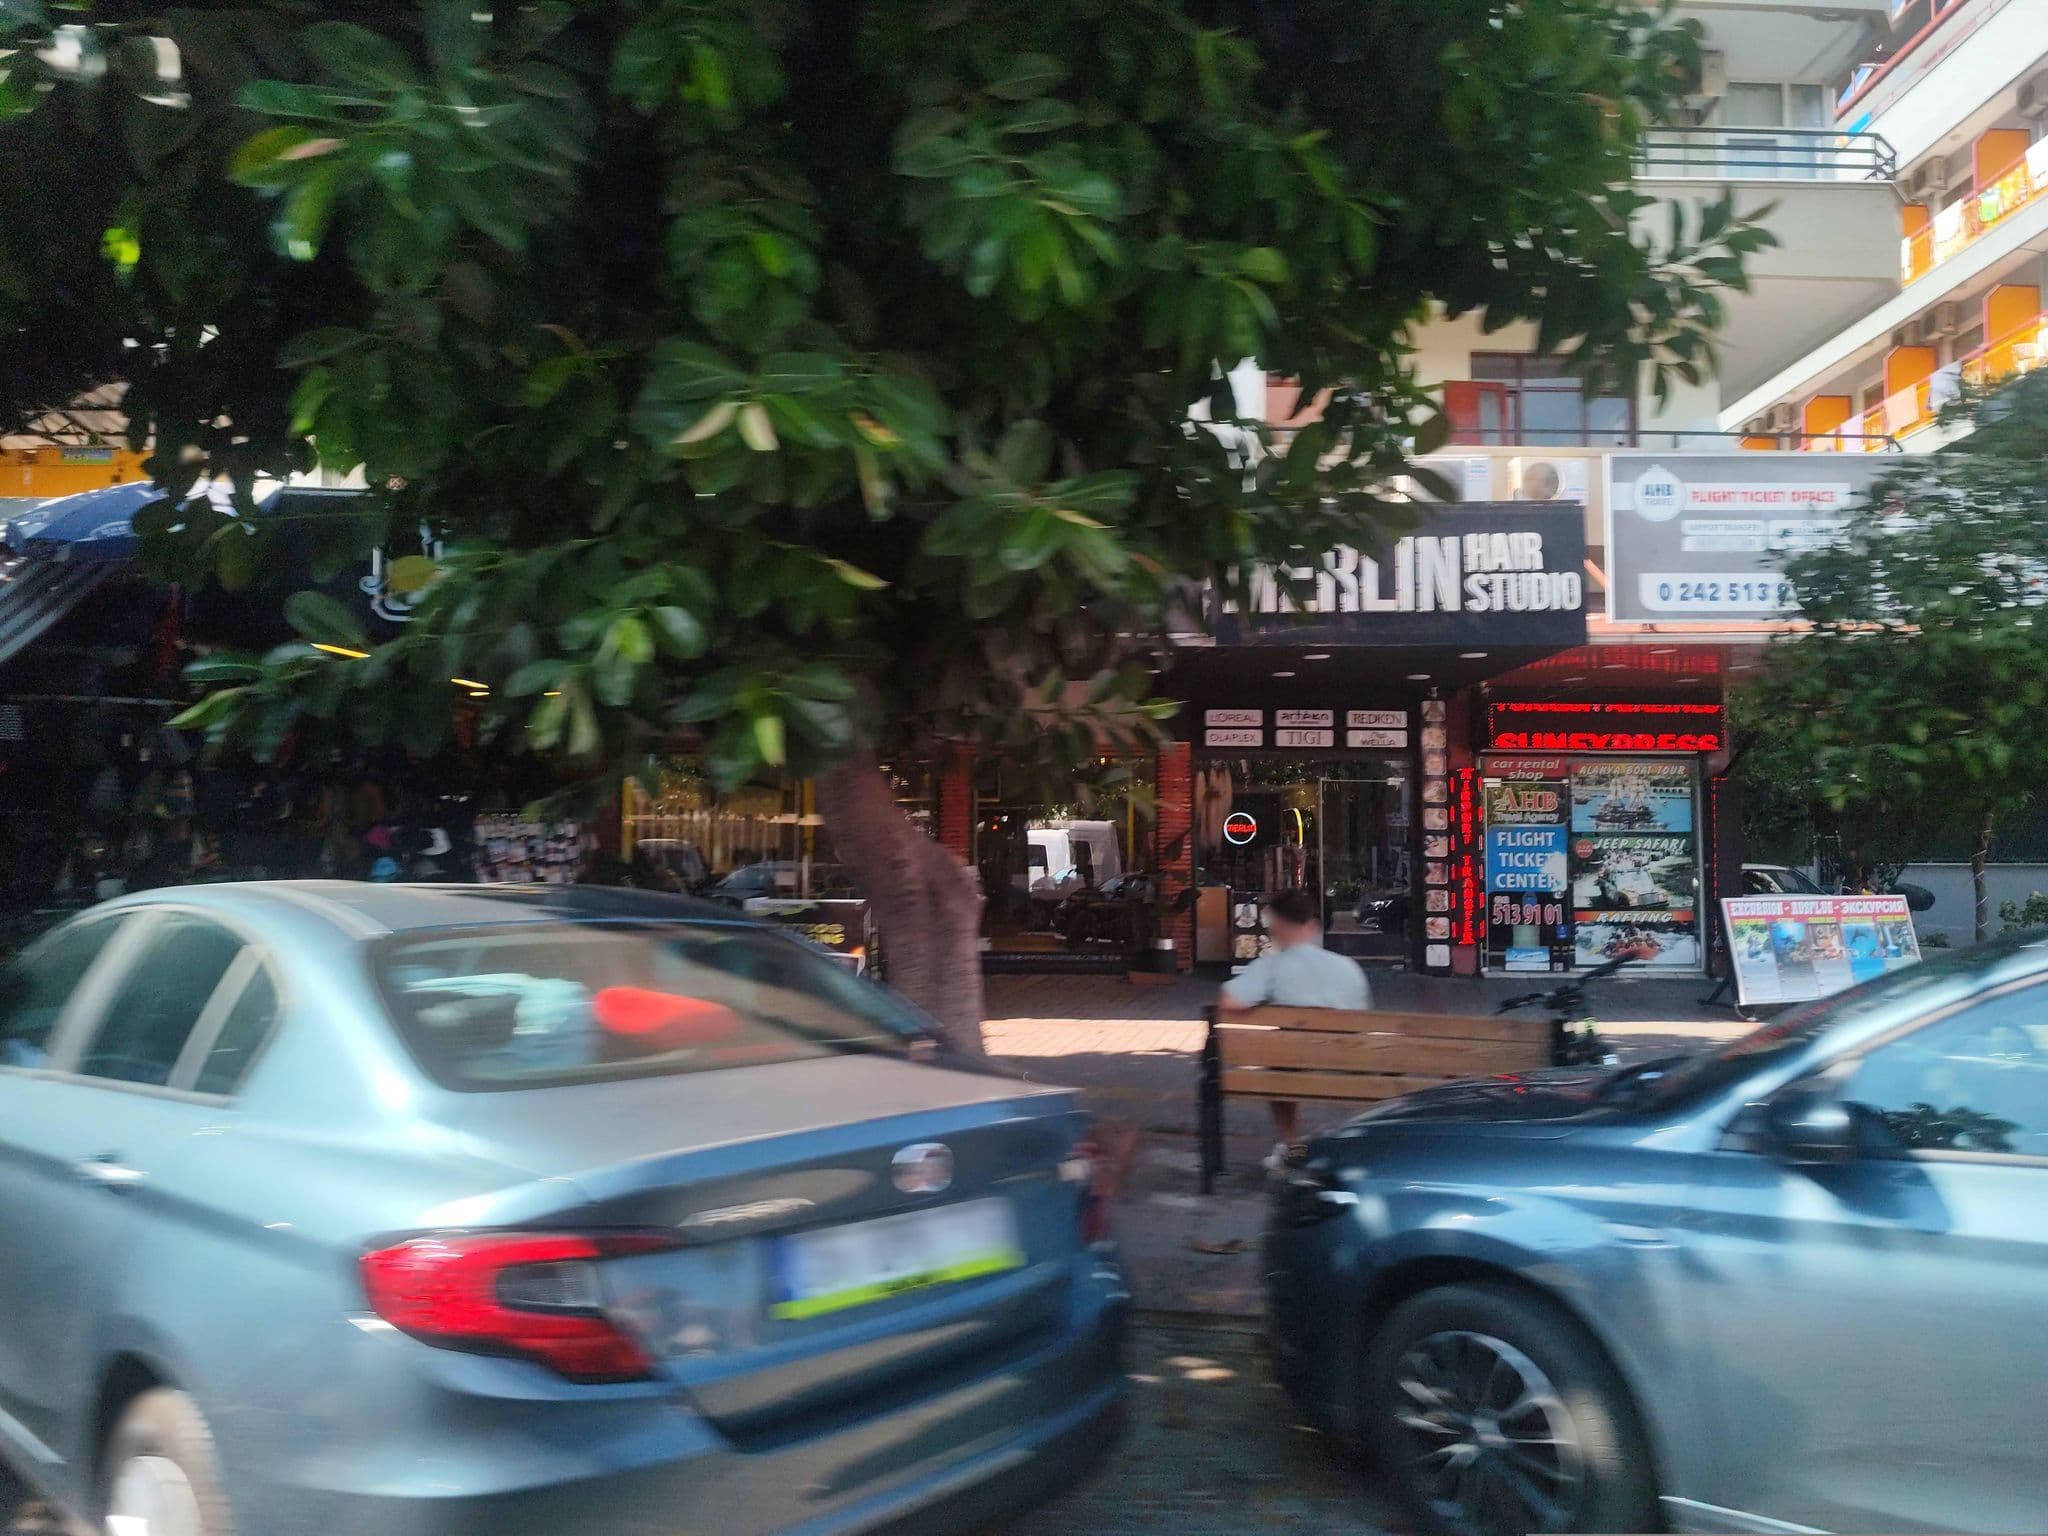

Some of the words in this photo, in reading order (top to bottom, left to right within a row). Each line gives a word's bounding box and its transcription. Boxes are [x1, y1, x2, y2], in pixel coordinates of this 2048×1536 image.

[1691, 490, 1737, 503] FLIGHT
[1741, 490, 1785, 503] TICKET
[1791, 490, 1835, 503] OFFICE
[1463, 532, 1543, 573] HAIR
[1463, 572, 1583, 613] STUDIO
[1659, 583, 1674, 601] 0
[1680, 583, 1721, 601] 242
[1728, 583, 1770, 601] 513
[1352, 713, 1402, 724] REDKEN
[1286, 732, 1321, 745] TIGI
[1492, 760, 1515, 769] car
[1517, 759, 1560, 769] rental
[1579, 766, 1620, 775] ALANYA
[1626, 766, 1652, 775] BOAT
[1657, 766, 1686, 775] TOUR
[1508, 770, 1544, 781] shop
[1493, 787, 1559, 812] AHB
[1497, 832, 1556, 847] FLIGHT
[1592, 839, 1629, 850] JEEP
[1634, 839, 1687, 850] SAFARI
[1499, 852, 1553, 867] TICKET
[1495, 873, 1557, 889] CENTER
[1492, 903, 1521, 925] 513
[1523, 903, 1541, 925] 91
[1544, 903, 1563, 925] 01
[1840, 900, 1906, 914] ЭКСКУРСИЯ
[1596, 912, 1673, 922] RAFTING
